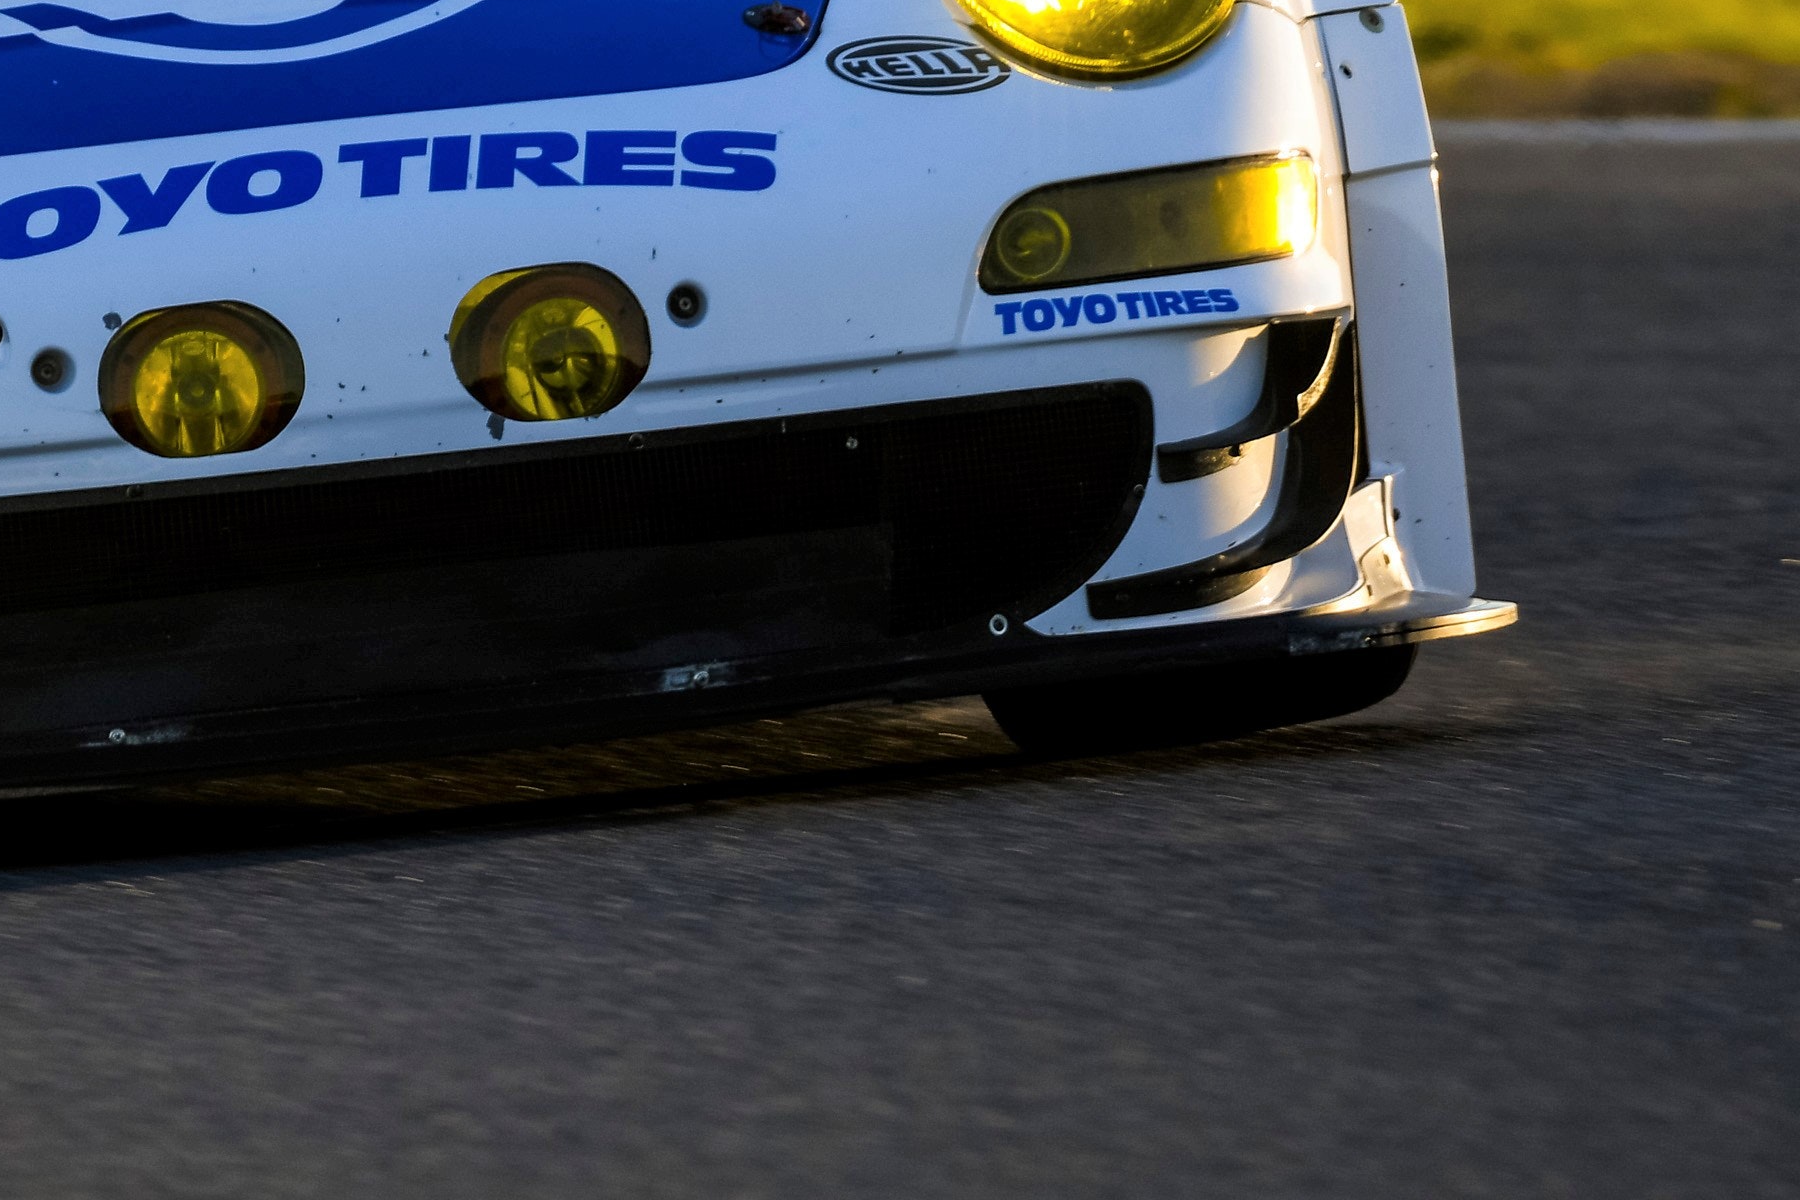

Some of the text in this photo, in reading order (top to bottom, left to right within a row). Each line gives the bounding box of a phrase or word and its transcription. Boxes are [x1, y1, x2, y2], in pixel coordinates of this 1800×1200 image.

[840, 47, 1011, 79] HELLA
[337, 130, 777, 199] TIRES
[994, 288, 1239, 336] TOYO TIRES
